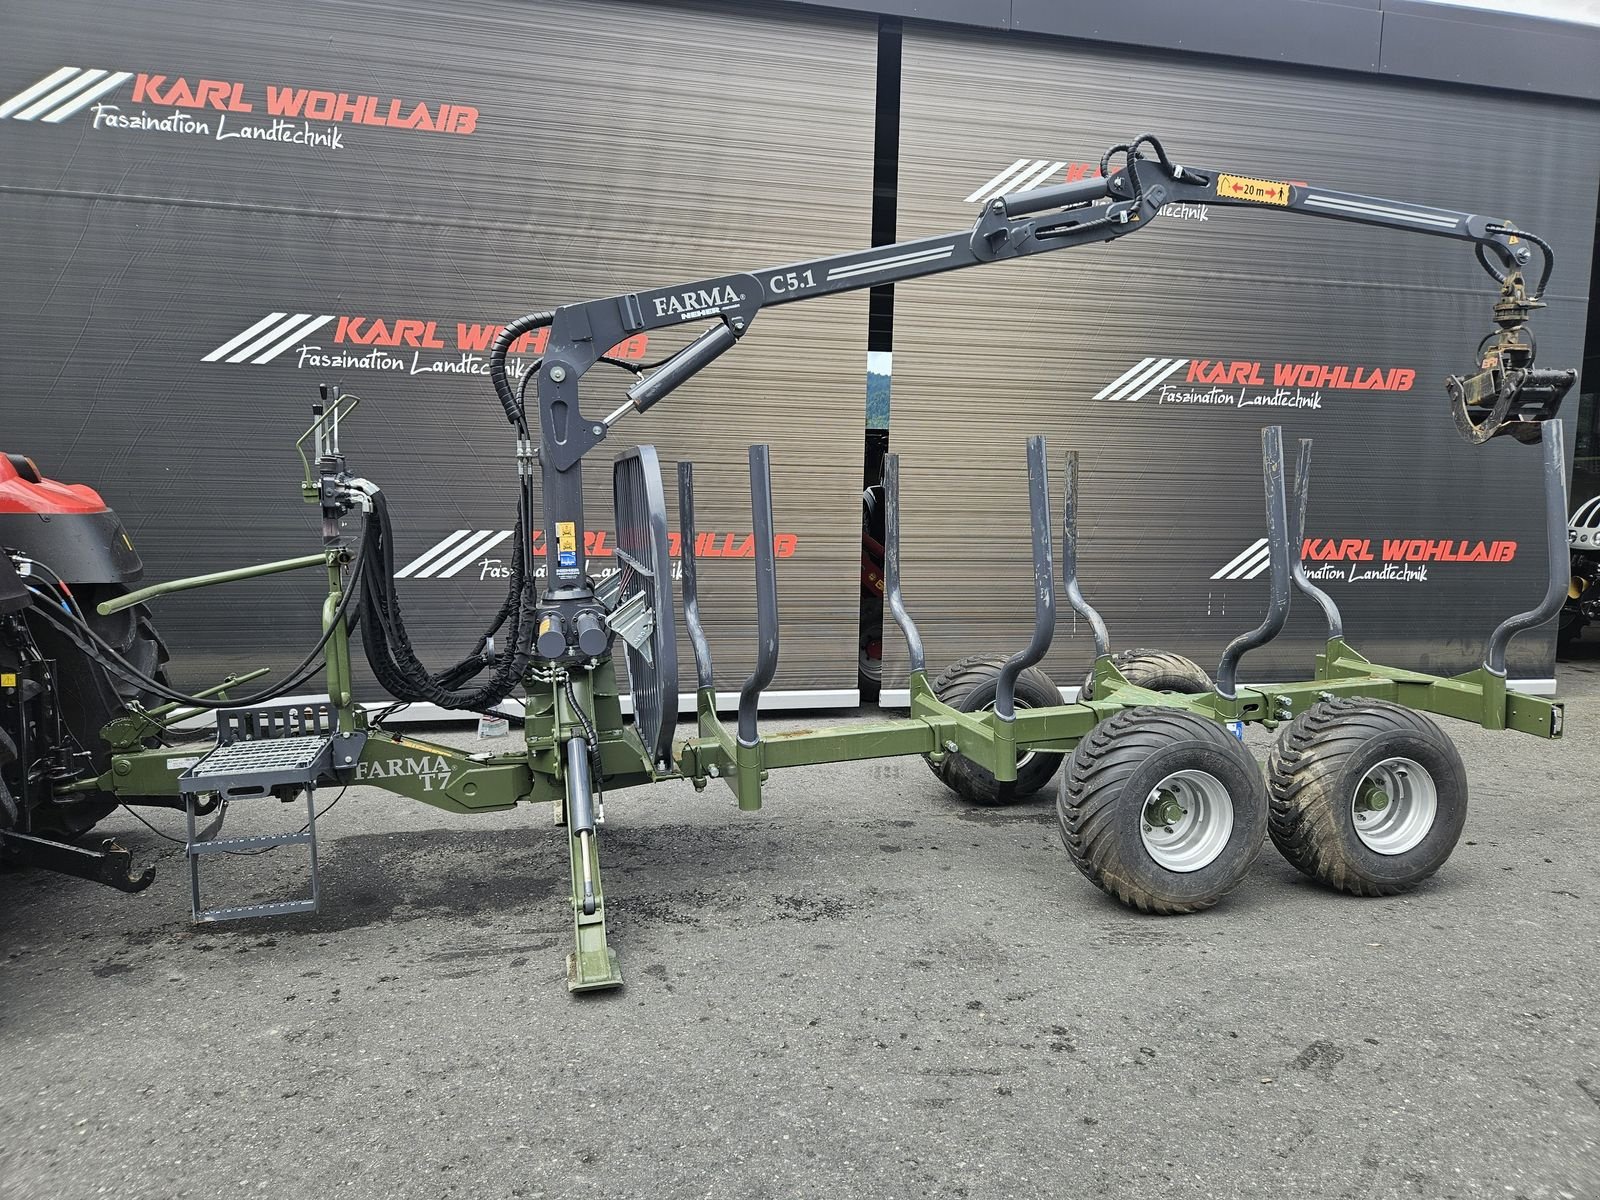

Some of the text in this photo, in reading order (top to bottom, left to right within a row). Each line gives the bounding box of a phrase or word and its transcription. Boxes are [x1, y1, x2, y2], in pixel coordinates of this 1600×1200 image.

[132, 73, 479, 134] KARL WOHLLAIB
[91, 103, 344, 149] Faszination Landtechnik
[1243, 184, 1265, 197] 20 m
[653, 284, 741, 317] FARMA
[334, 316, 444, 349] KARL
[296, 345, 525, 379] Faszination Landtecnik
[1186, 360, 1416, 391] KARL WOHLLAIB
[1158, 384, 1322, 410] Faszination Landtechnik
[1301, 538, 1518, 562] KARL WOHLLAIB
[1303, 562, 1428, 583] ination Landtechnik
[354, 755, 452, 781] FARMA
[418, 771, 452, 792] T7
